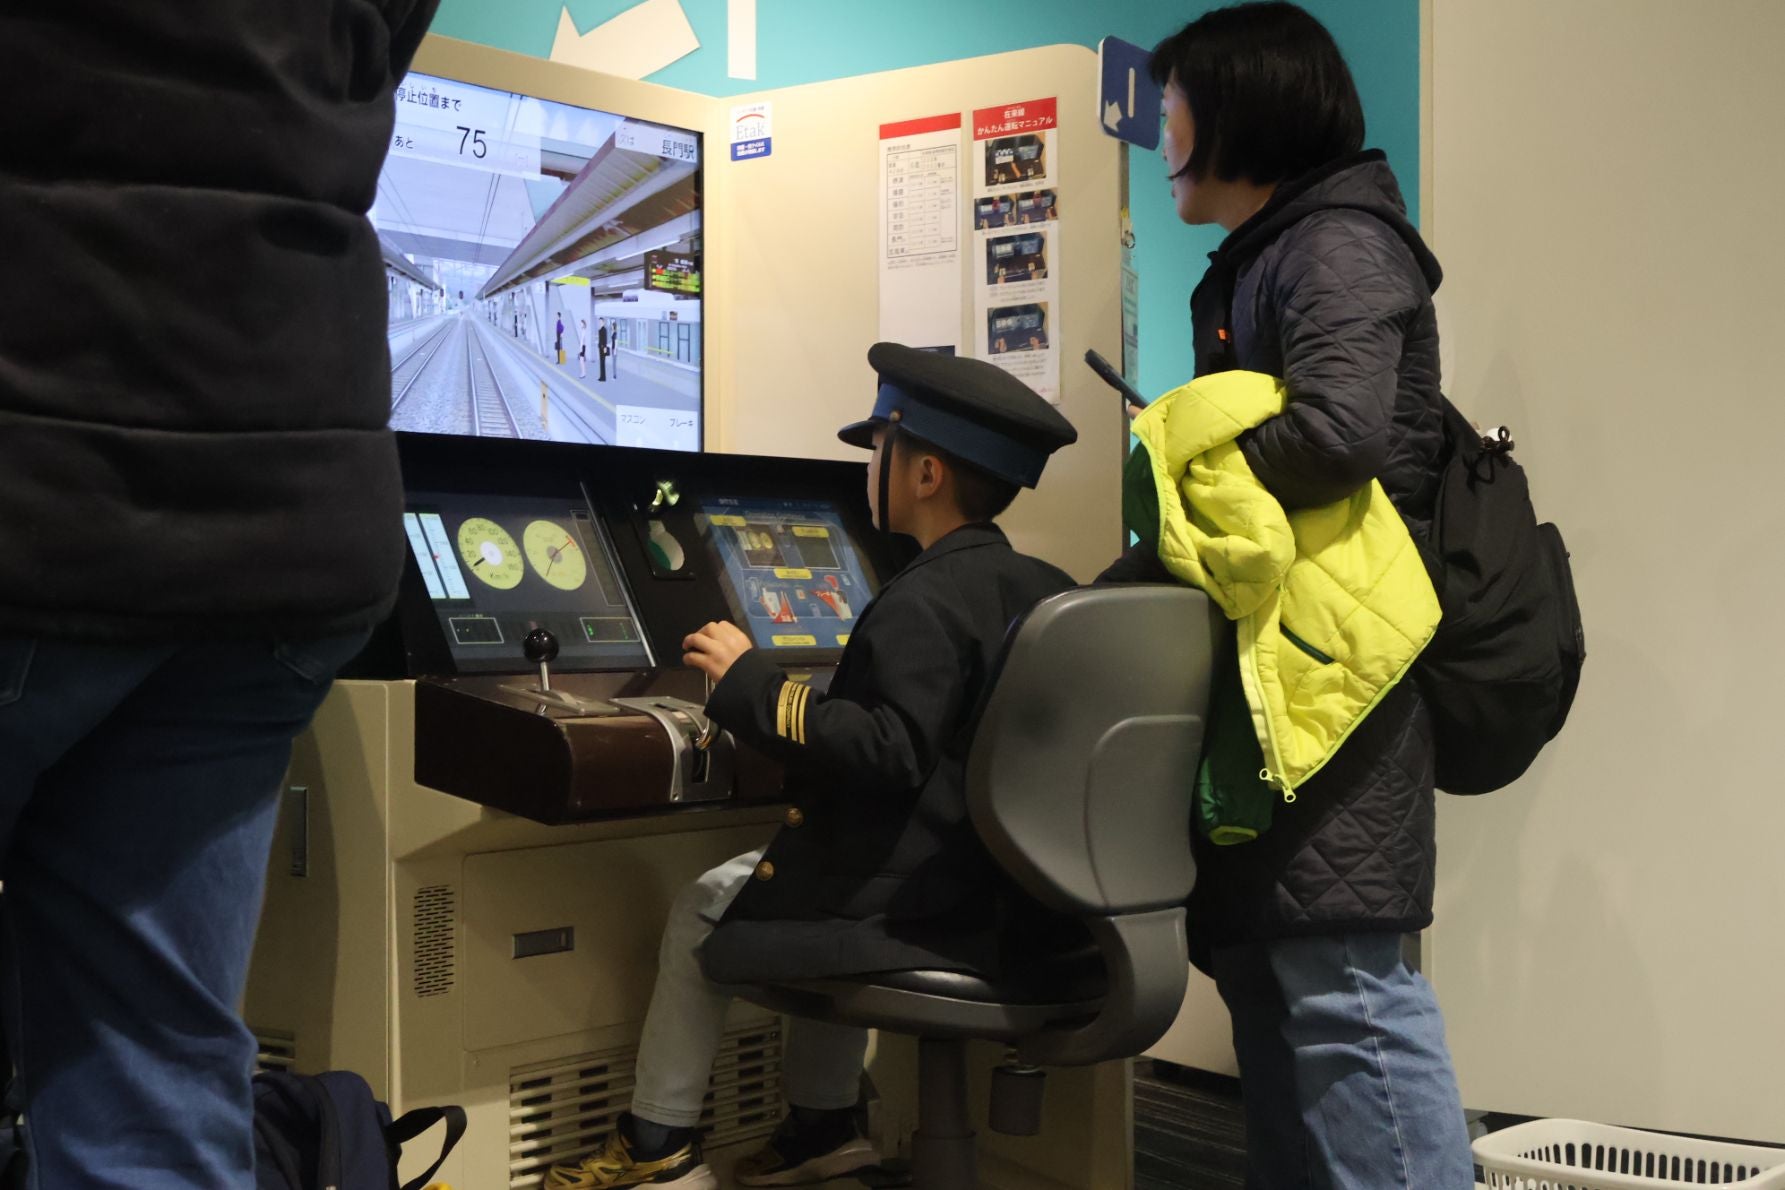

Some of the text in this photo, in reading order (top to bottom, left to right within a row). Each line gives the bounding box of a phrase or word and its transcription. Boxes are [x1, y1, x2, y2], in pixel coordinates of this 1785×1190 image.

[396, 87, 461, 112] 停止位置まで
[736, 122, 765, 140] Etak
[977, 116, 1053, 136] かんたん運転マニュアル
[394, 135, 414, 149] あと
[456, 126, 487, 159] 75
[661, 138, 696, 160] 長門駅
[620, 413, 646, 425] マスコン
